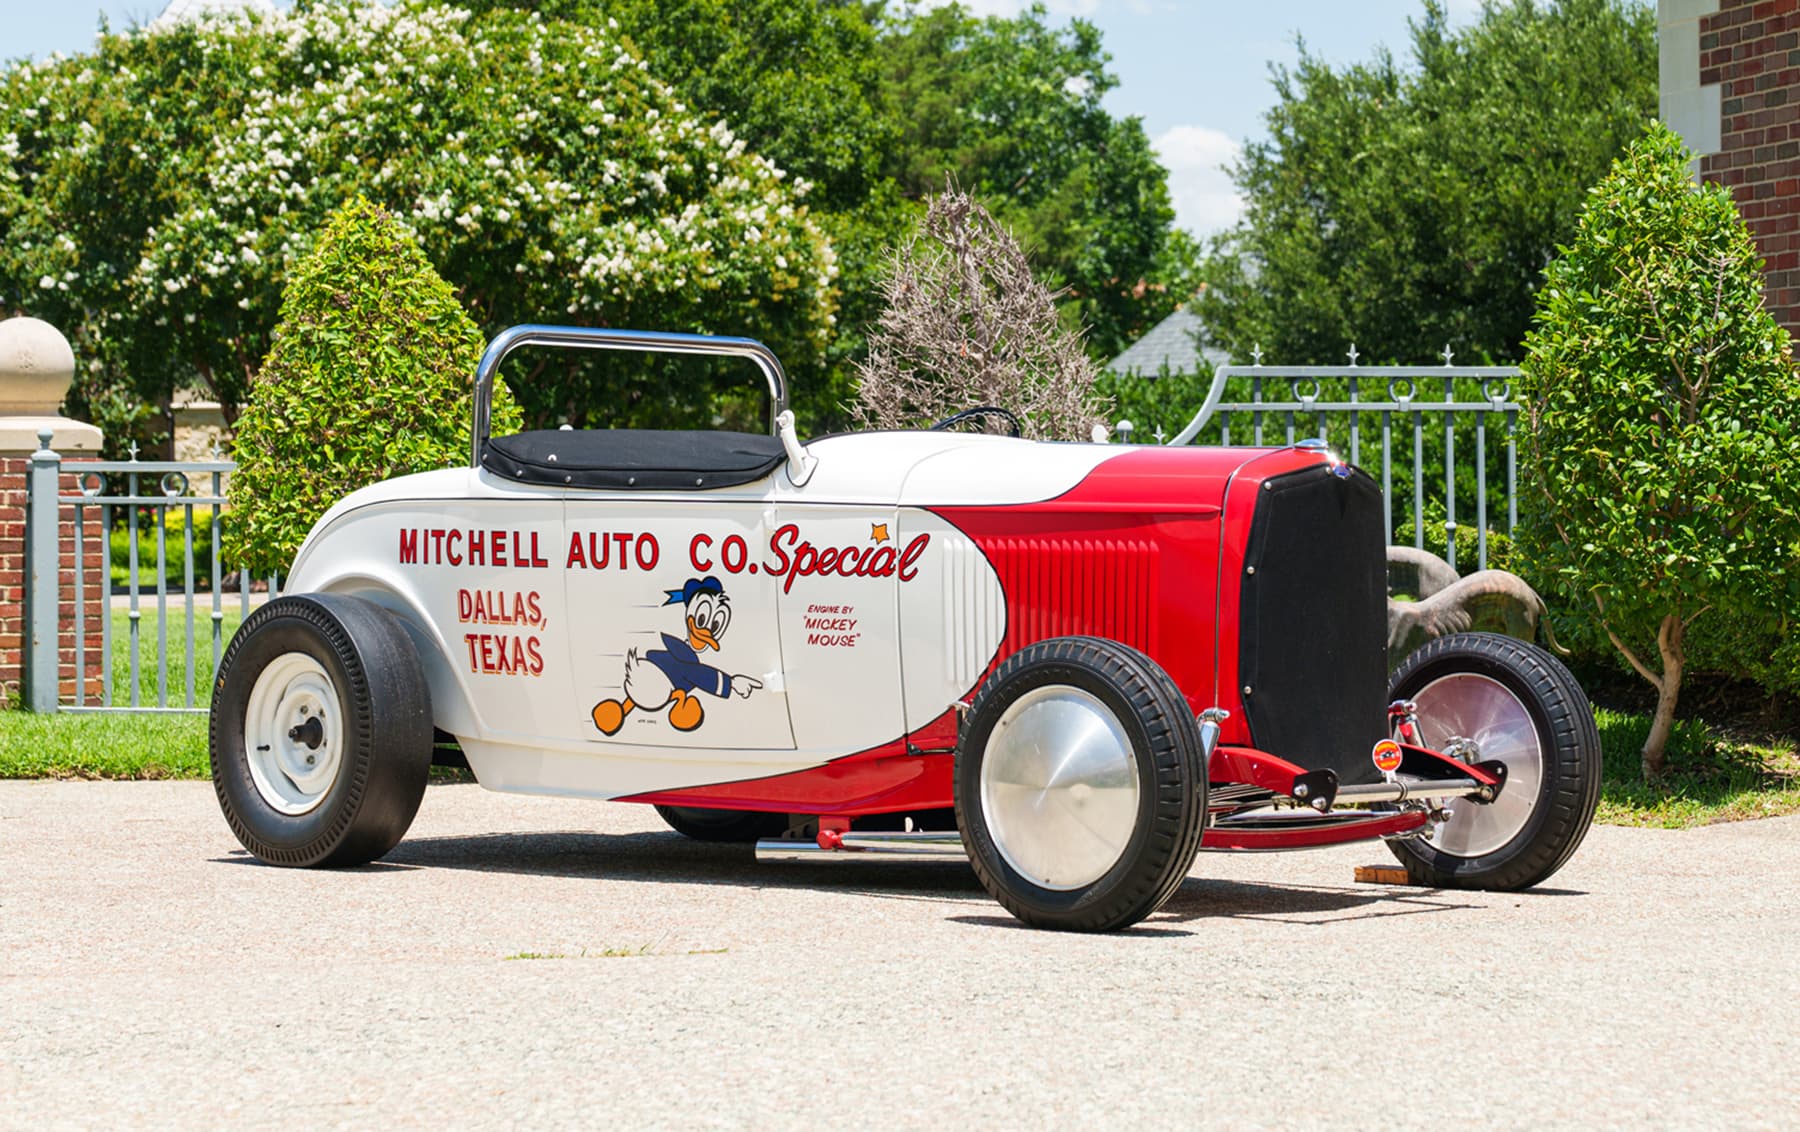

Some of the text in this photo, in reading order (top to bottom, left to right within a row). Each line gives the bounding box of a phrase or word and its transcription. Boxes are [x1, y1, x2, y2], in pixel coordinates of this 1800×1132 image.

[399, 524, 931, 594] MITCHELL AUTO CO. Special
[457, 588, 547, 631] DALLAS,
[807, 604, 854, 615] ENGINE BY
[464, 633, 544, 677] TEXAS
